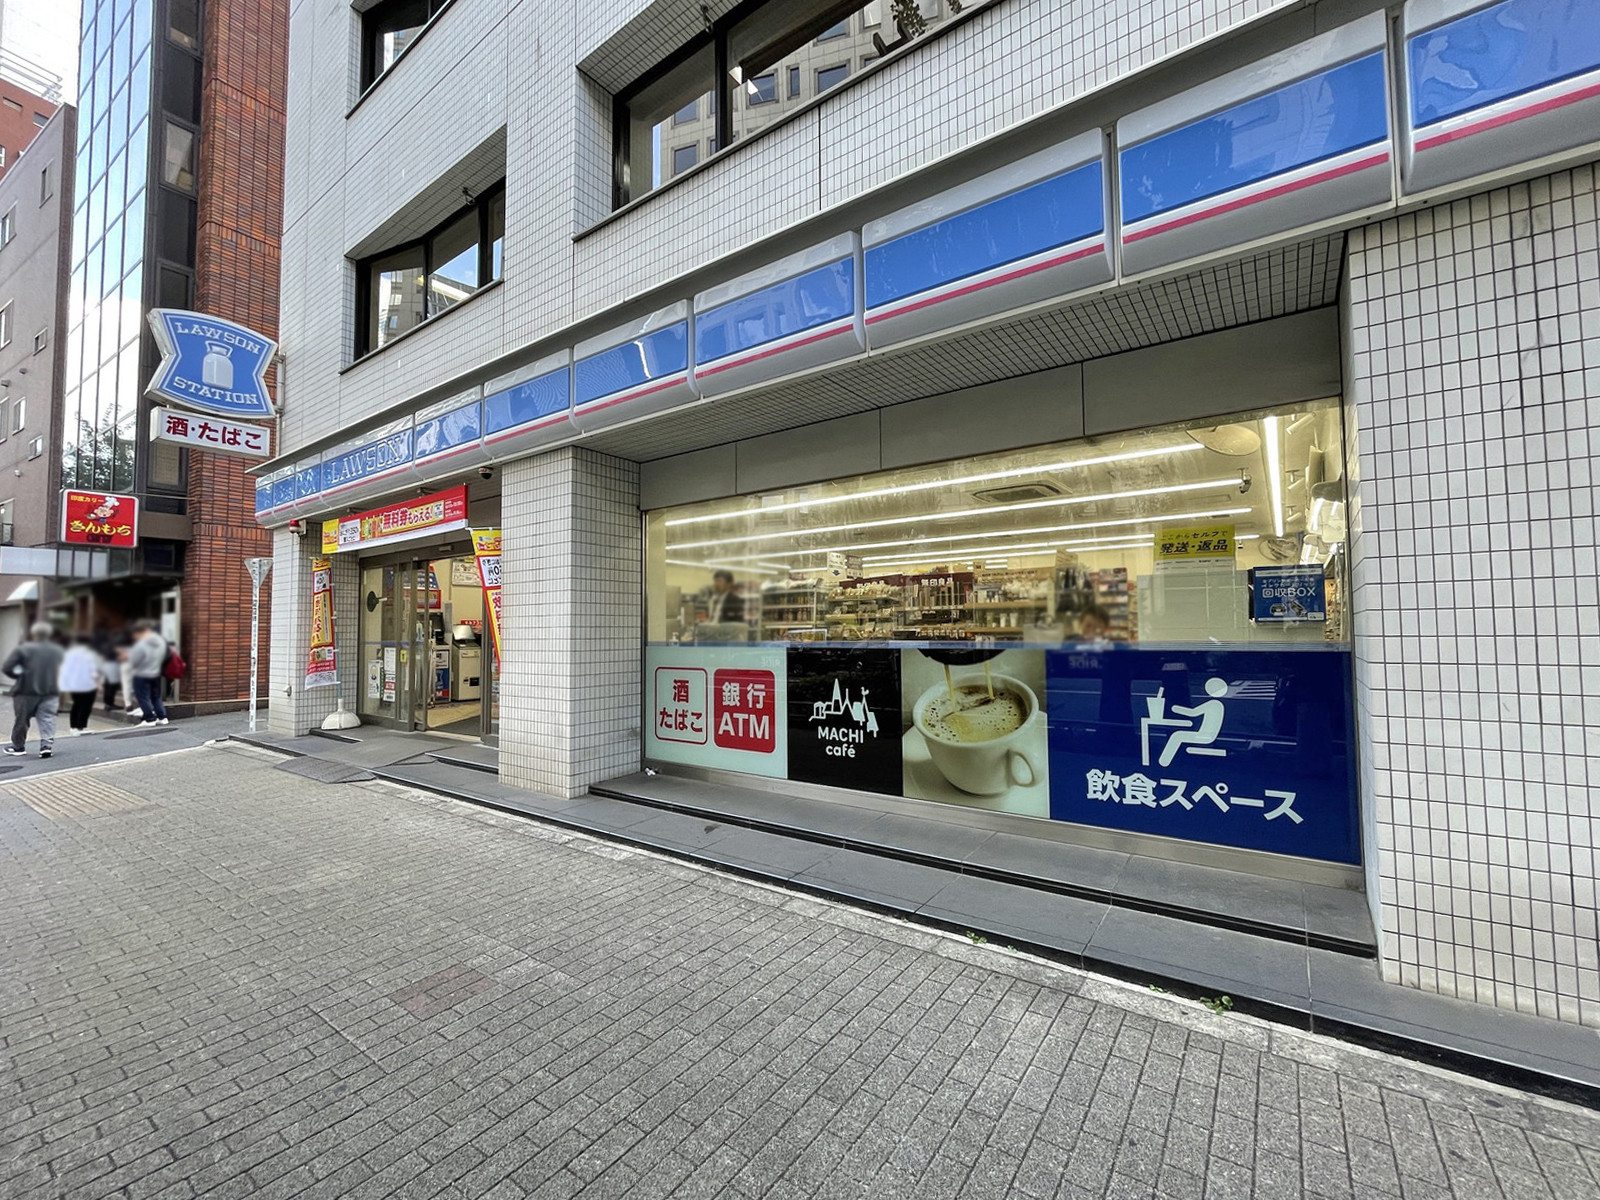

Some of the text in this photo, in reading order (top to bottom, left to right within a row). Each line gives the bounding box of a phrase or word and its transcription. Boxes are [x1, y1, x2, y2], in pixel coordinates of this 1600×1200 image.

[176, 322, 261, 355] LAWSON
[173, 376, 259, 405] STATION
[166, 415, 262, 450] 酒・たばこ
[330, 440, 402, 484] LAWSON
[1161, 539, 1228, 553] 発送・返品
[1262, 587, 1316, 598] 回収BOX
[673, 679, 690, 703] 酒
[722, 683, 766, 709] 銀行
[659, 709, 704, 734] たばこ
[718, 712, 770, 740] ATM
[817, 726, 864, 744] MACHI
[825, 743, 856, 758] café
[1086, 769, 1304, 824] 飲食スペース
